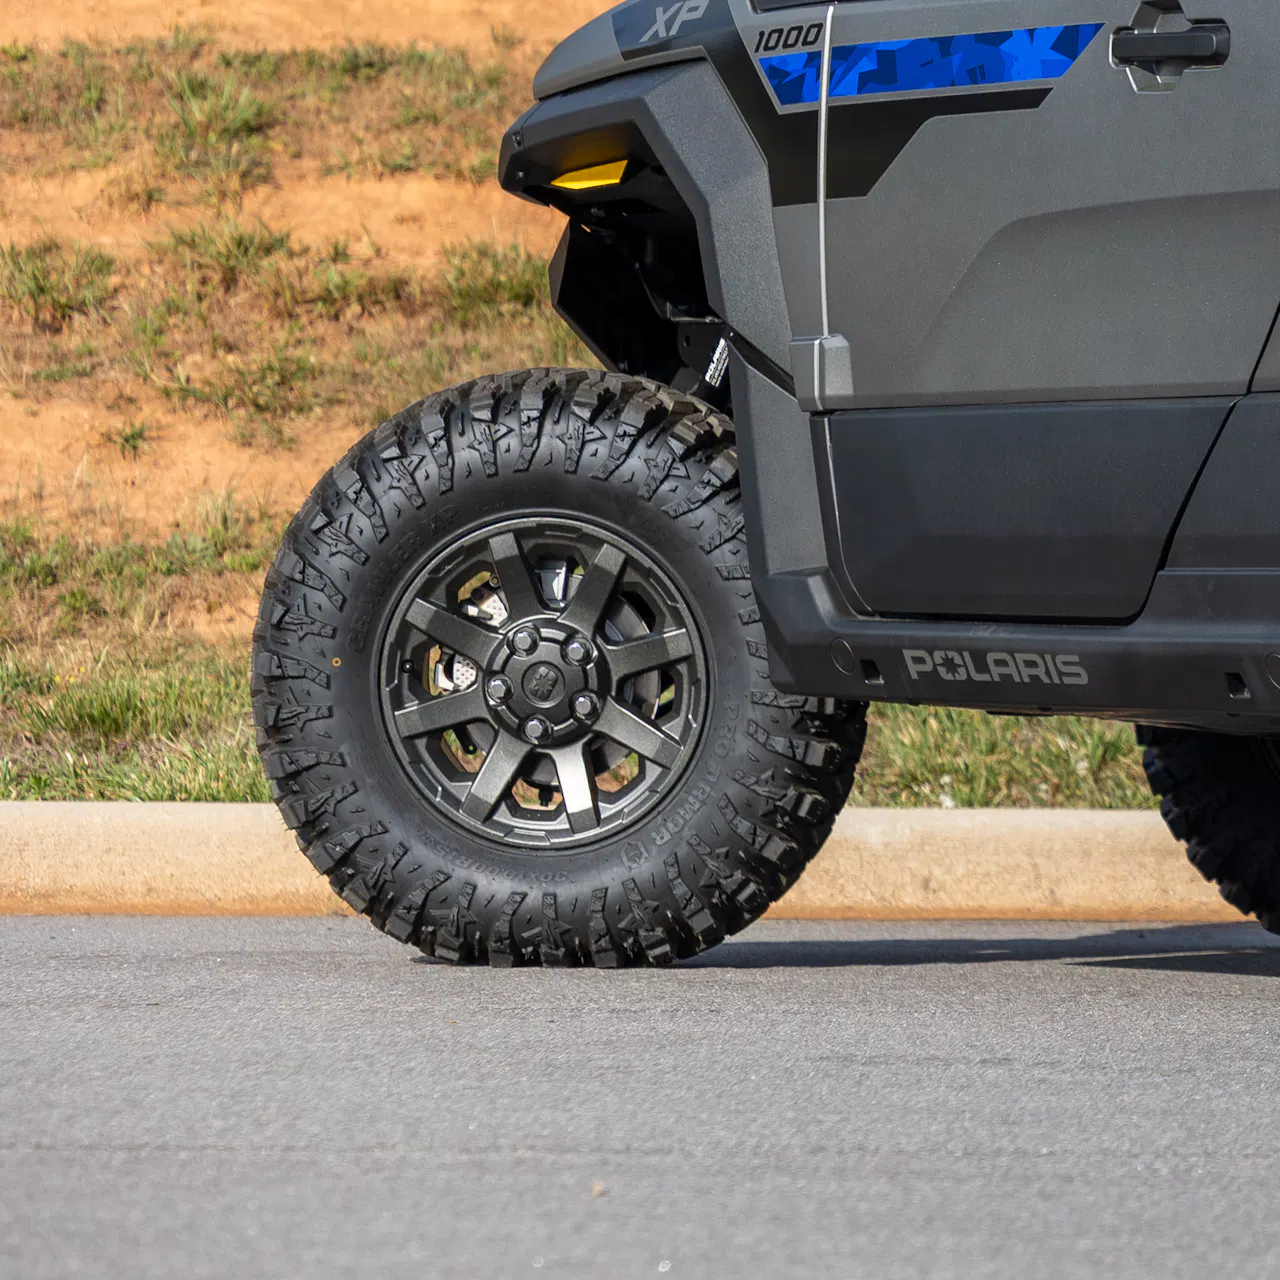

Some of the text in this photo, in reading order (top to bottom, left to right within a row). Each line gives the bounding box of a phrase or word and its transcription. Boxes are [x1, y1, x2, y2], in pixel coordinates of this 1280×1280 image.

[754, 22, 824, 54] 1000
[902, 649, 1089, 685] POLARIS
[649, 700, 741, 847] PRO ARMOR
